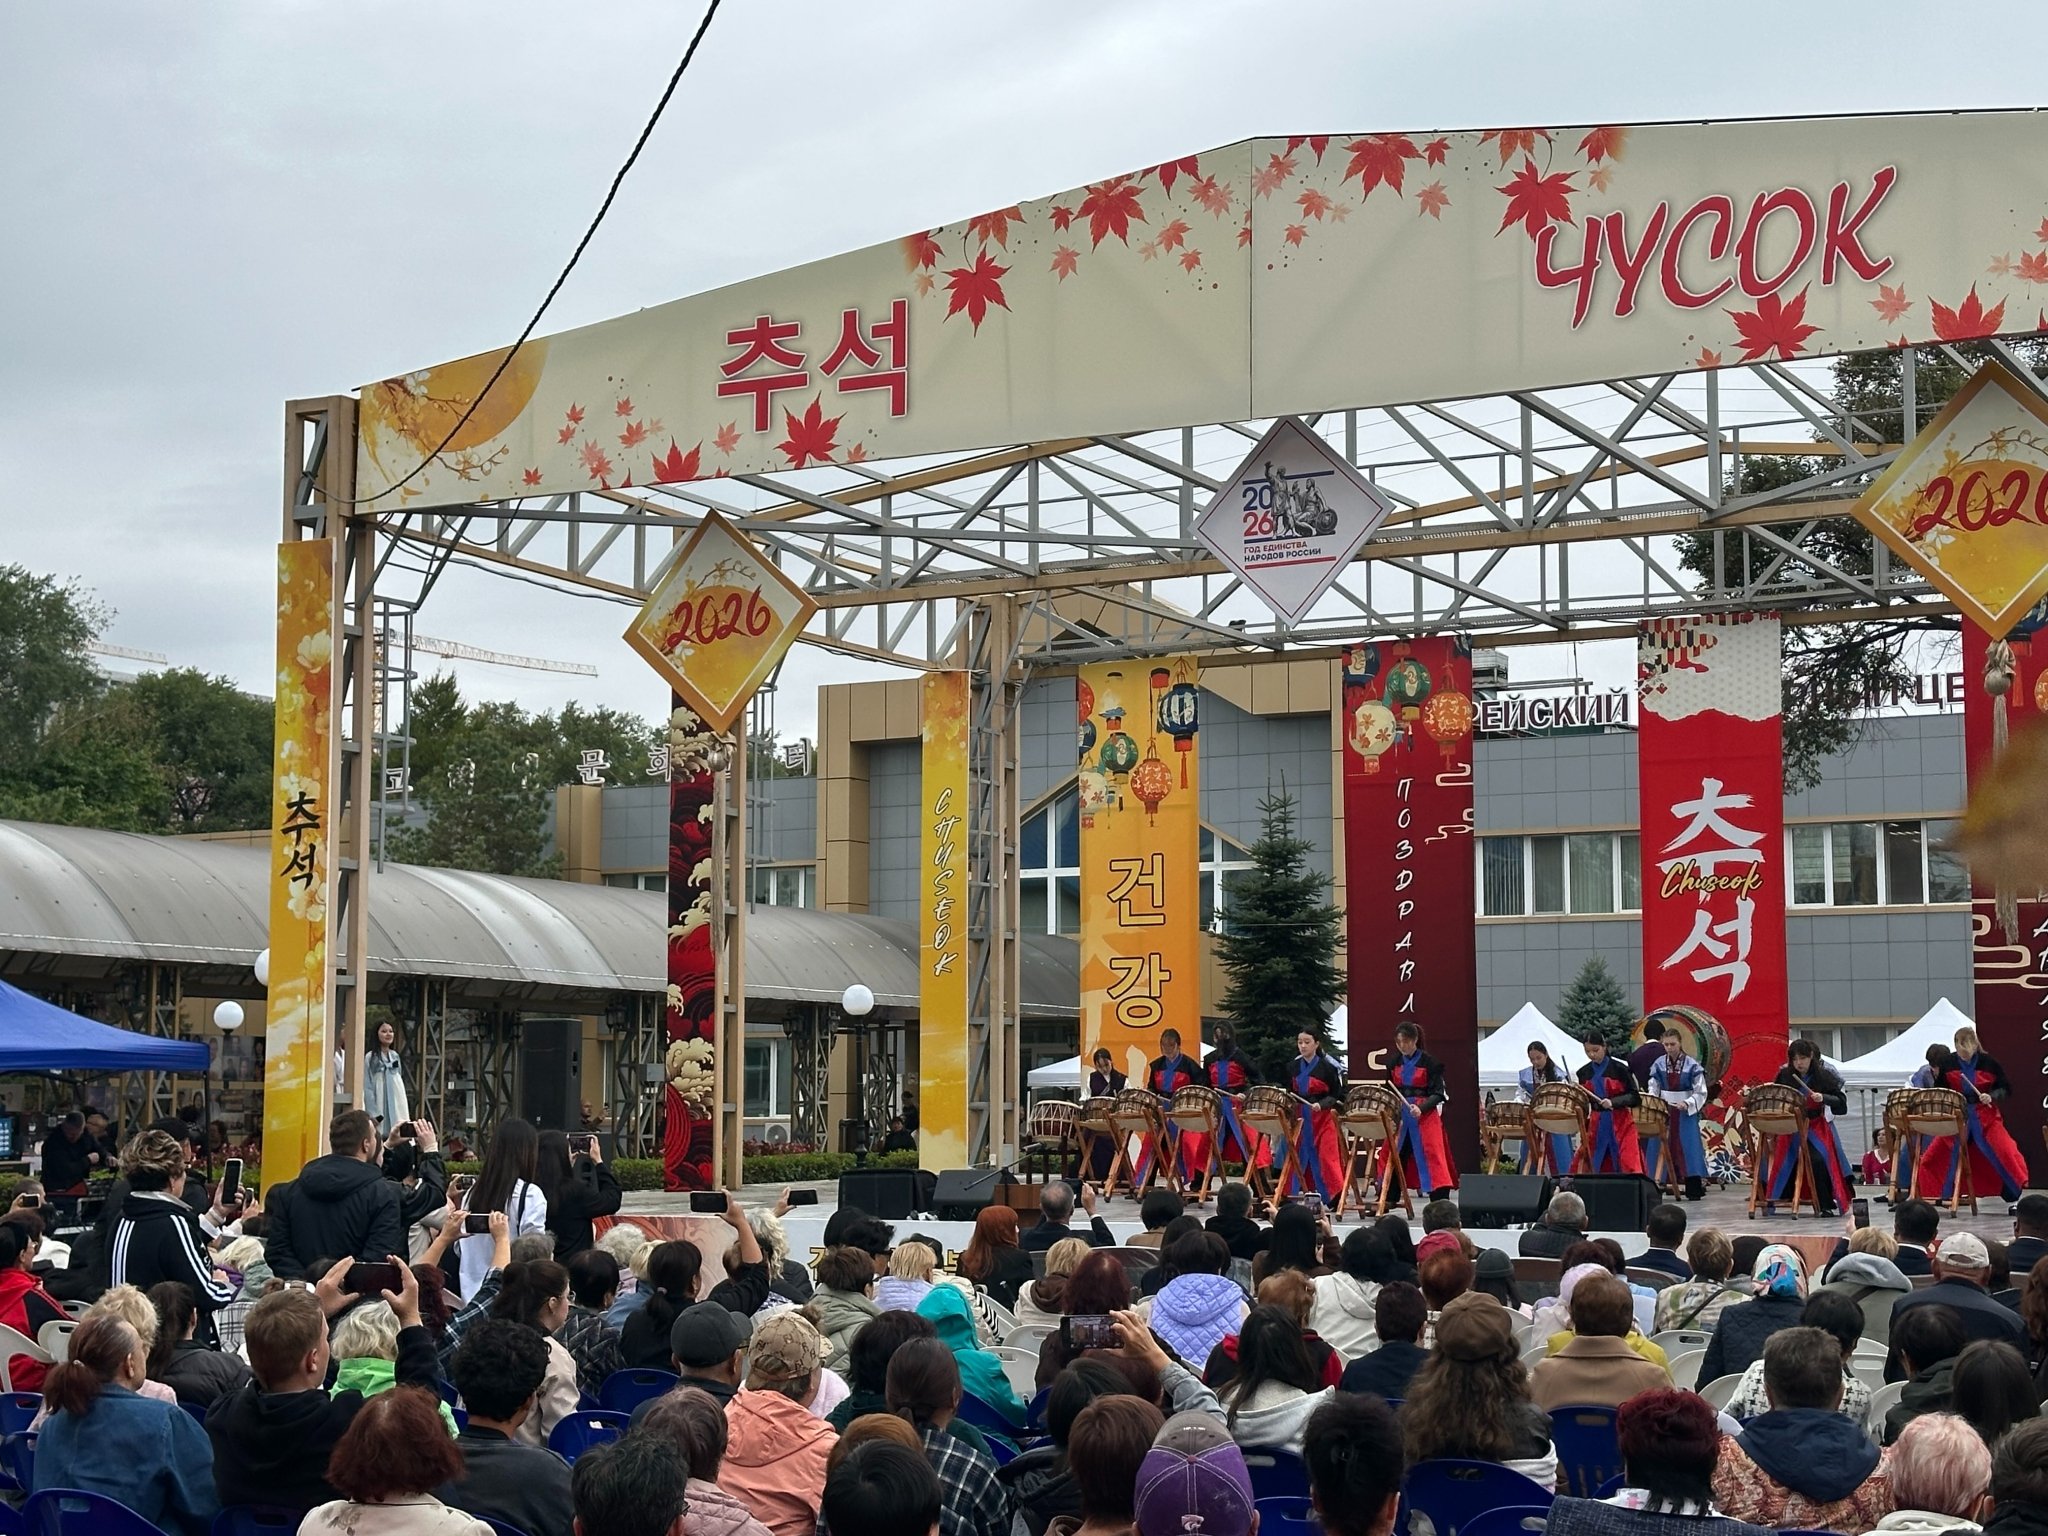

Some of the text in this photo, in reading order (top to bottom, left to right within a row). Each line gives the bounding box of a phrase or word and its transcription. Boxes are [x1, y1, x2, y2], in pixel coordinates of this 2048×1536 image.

[1535, 165, 1897, 330] ЧУСОК
[717, 298, 907, 432] 추석
[1242, 484, 1274, 512] 20
[1242, 510, 1274, 537] 26
[1244, 541, 1308, 554] ГОД ЕДИНСТВА
[1244, 548, 1322, 562] НАРОДОВ РОССИИ
[667, 584, 771, 648] 2026
[280, 791, 320, 891] 추석
[1660, 859, 1765, 901] Chuseok
[933, 788, 960, 977] CHUSEOK
[1655, 777, 1767, 1004] 추석
[1107, 853, 1172, 1028] 건강
